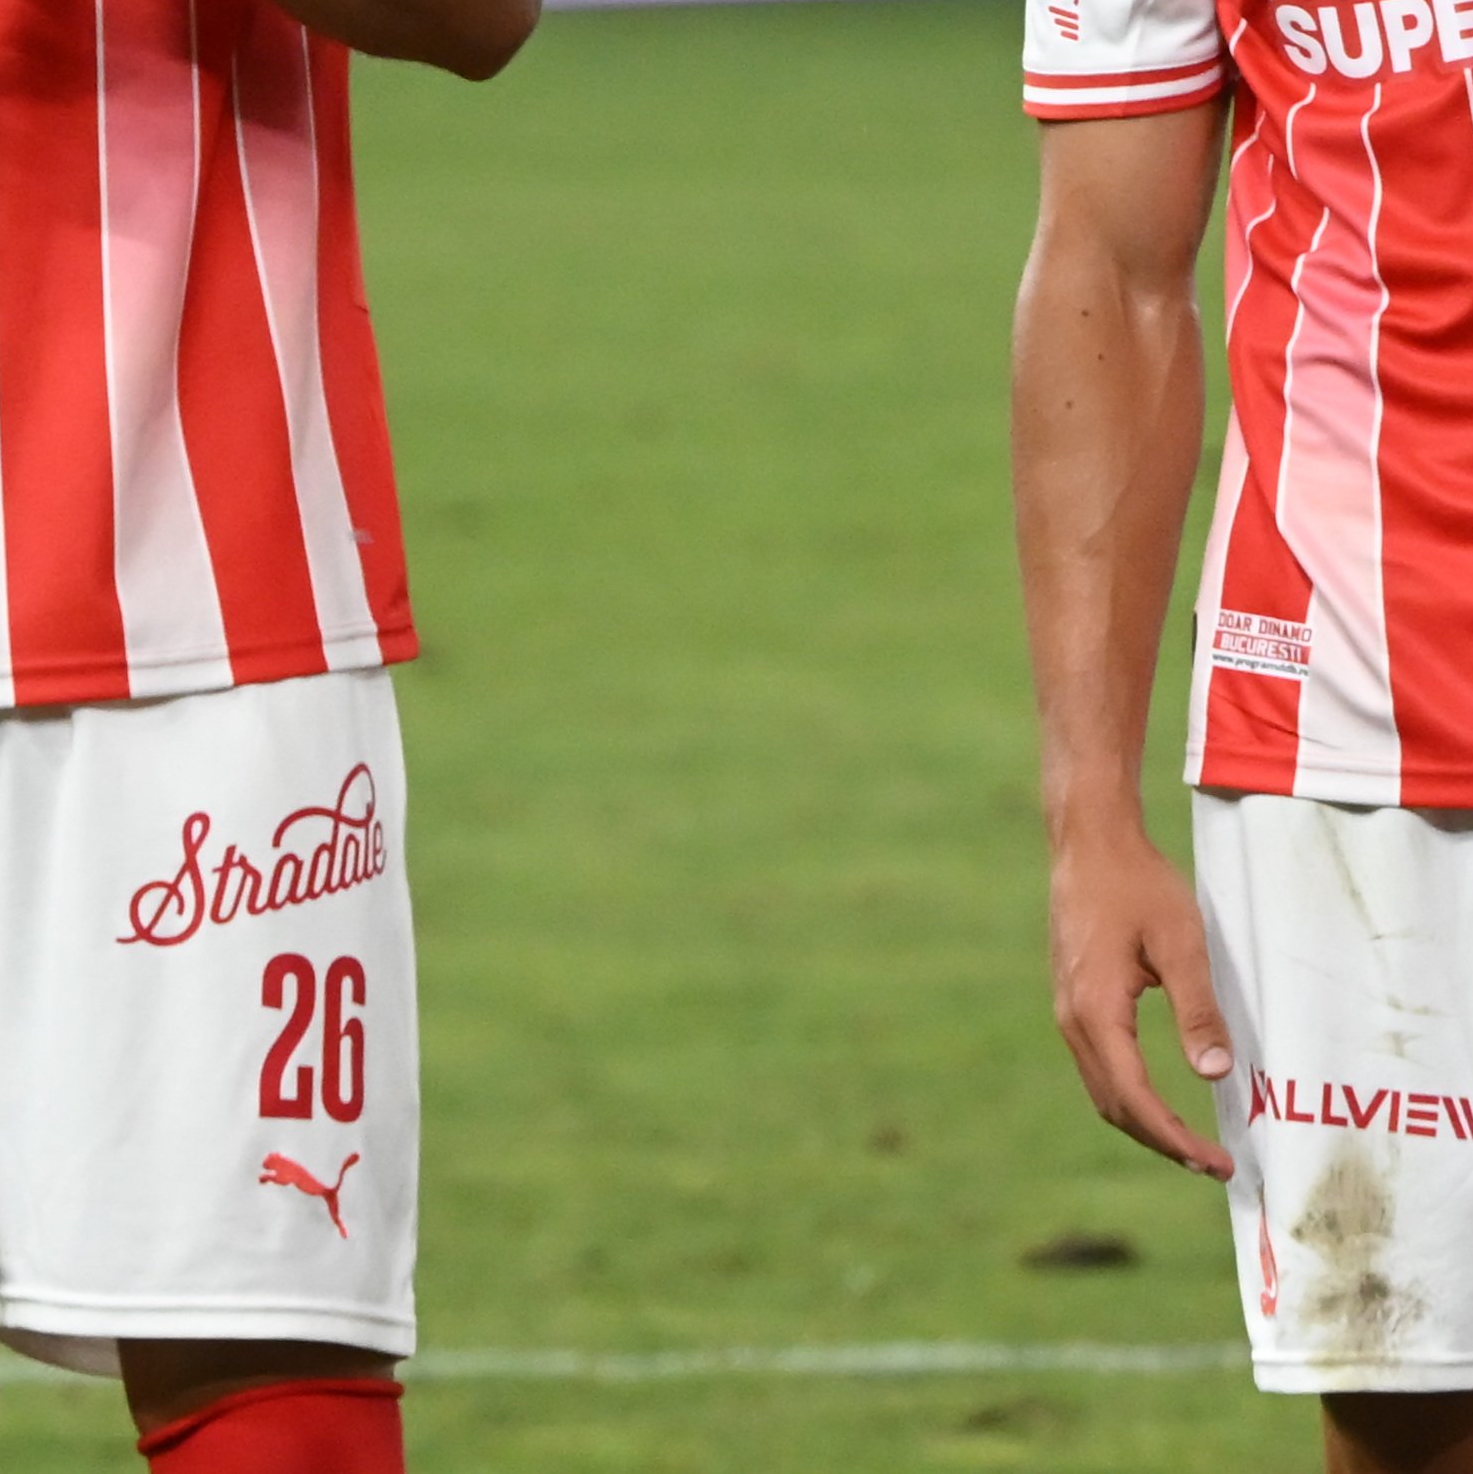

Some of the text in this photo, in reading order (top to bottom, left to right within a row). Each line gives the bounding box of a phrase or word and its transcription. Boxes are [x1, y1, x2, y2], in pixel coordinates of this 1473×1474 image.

[1218, 612, 1313, 643] DOAR DINAMO
[116, 761, 387, 947] Stradale
[259, 953, 366, 1123] 26
